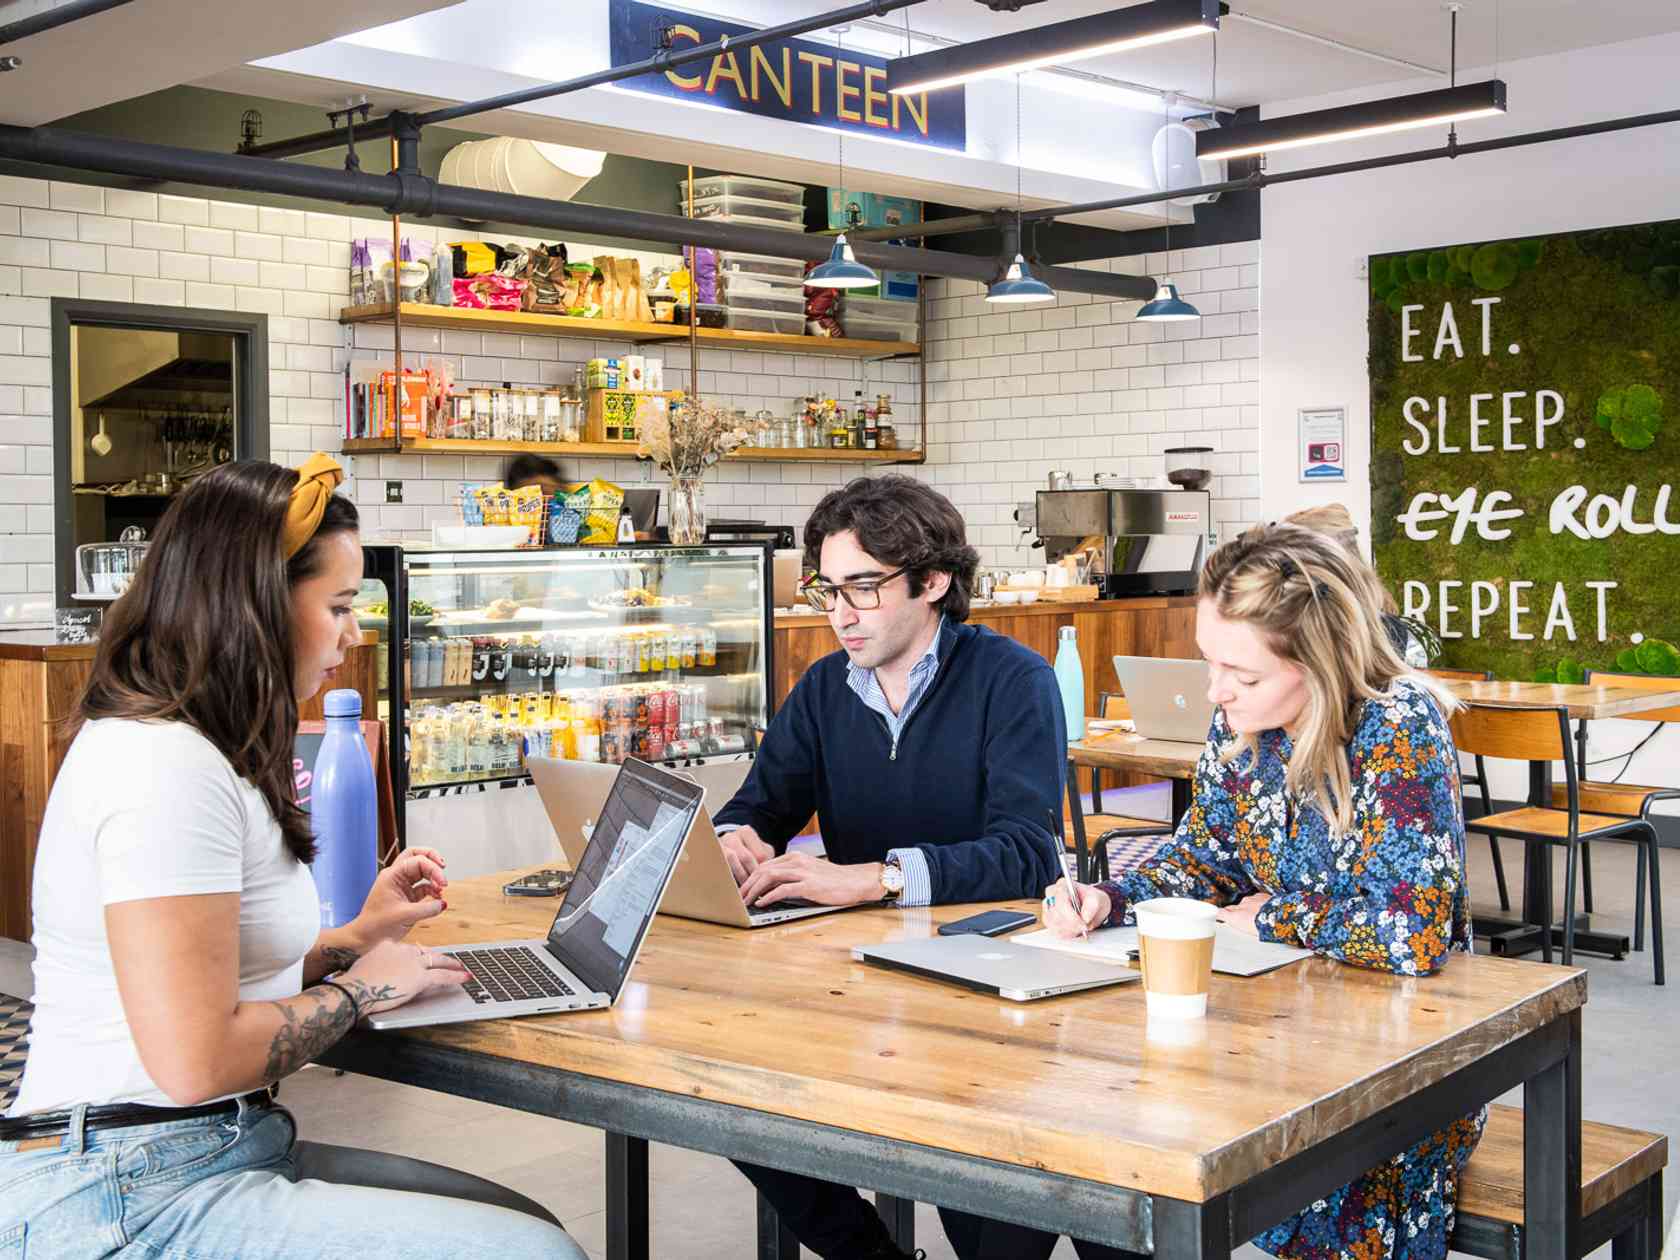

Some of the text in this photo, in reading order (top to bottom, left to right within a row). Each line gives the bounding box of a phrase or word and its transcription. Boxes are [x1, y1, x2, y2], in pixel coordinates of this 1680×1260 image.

[662, 23, 930, 137] CANTEEN
[1401, 296, 1521, 362] EAT.
[1402, 389, 1586, 456] SLEEP.
[1397, 484, 1680, 545] EYE ROLL
[1402, 579, 1645, 643] REPEAT.
